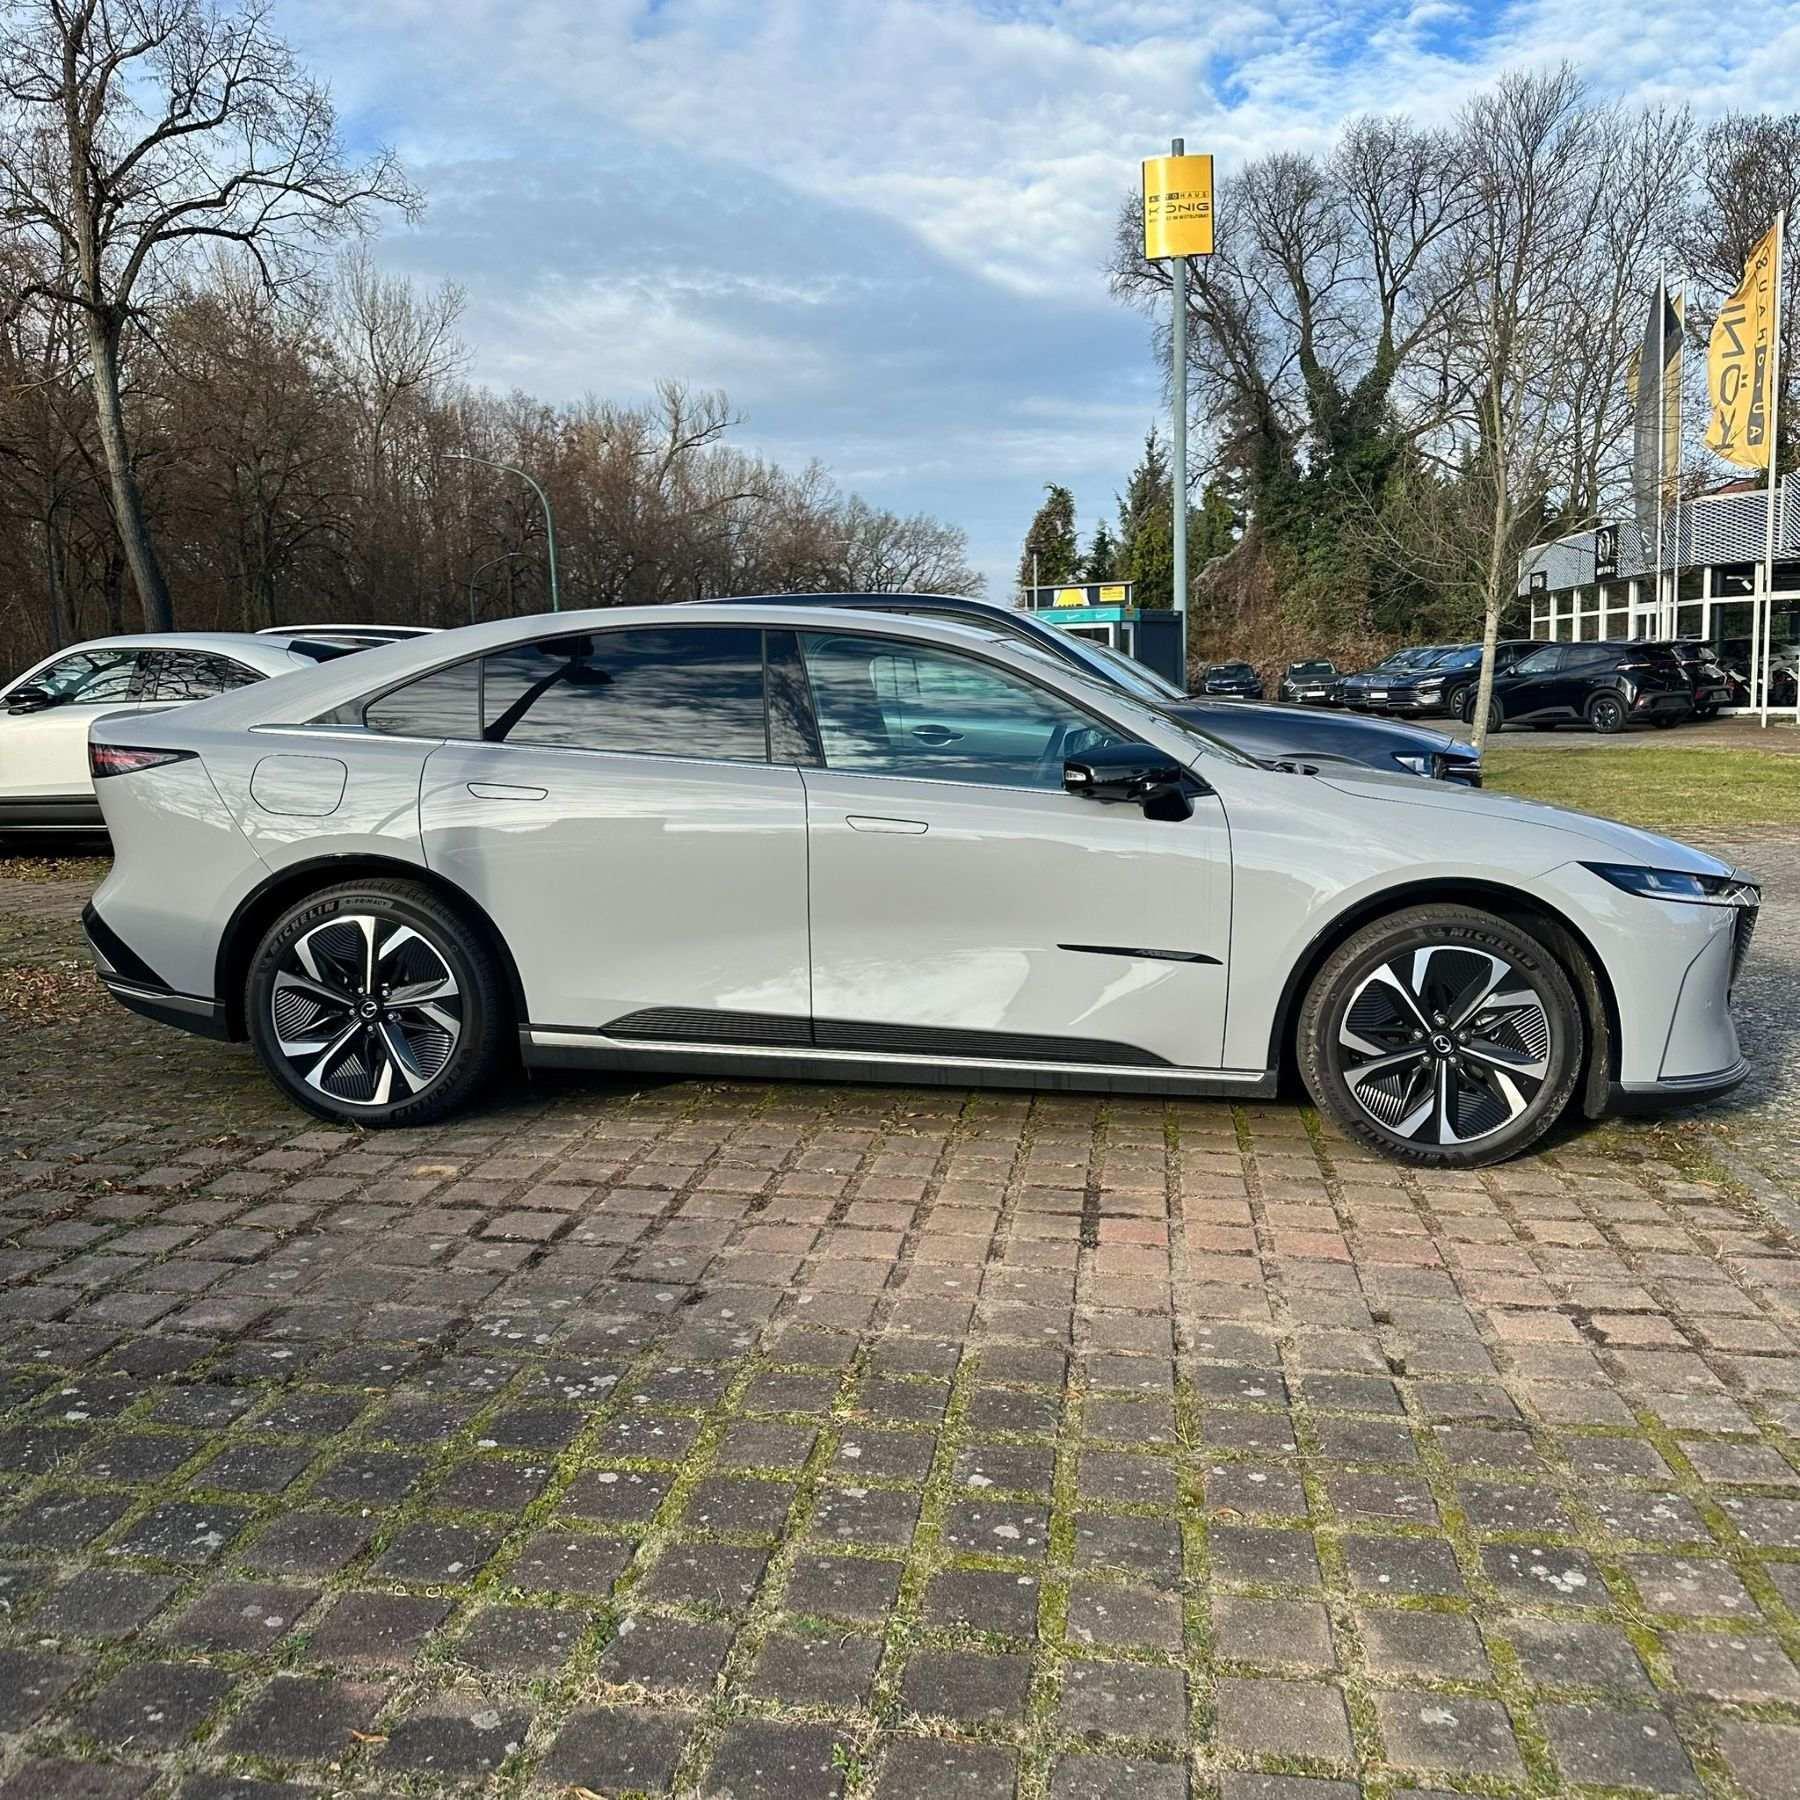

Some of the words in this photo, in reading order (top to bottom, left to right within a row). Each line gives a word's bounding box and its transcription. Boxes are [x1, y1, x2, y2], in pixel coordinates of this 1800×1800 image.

[1149, 192, 1207, 203] AOHAUS
[270, 901, 335, 955] MICHELIN
[1450, 927, 1537, 969] MICHELIN
